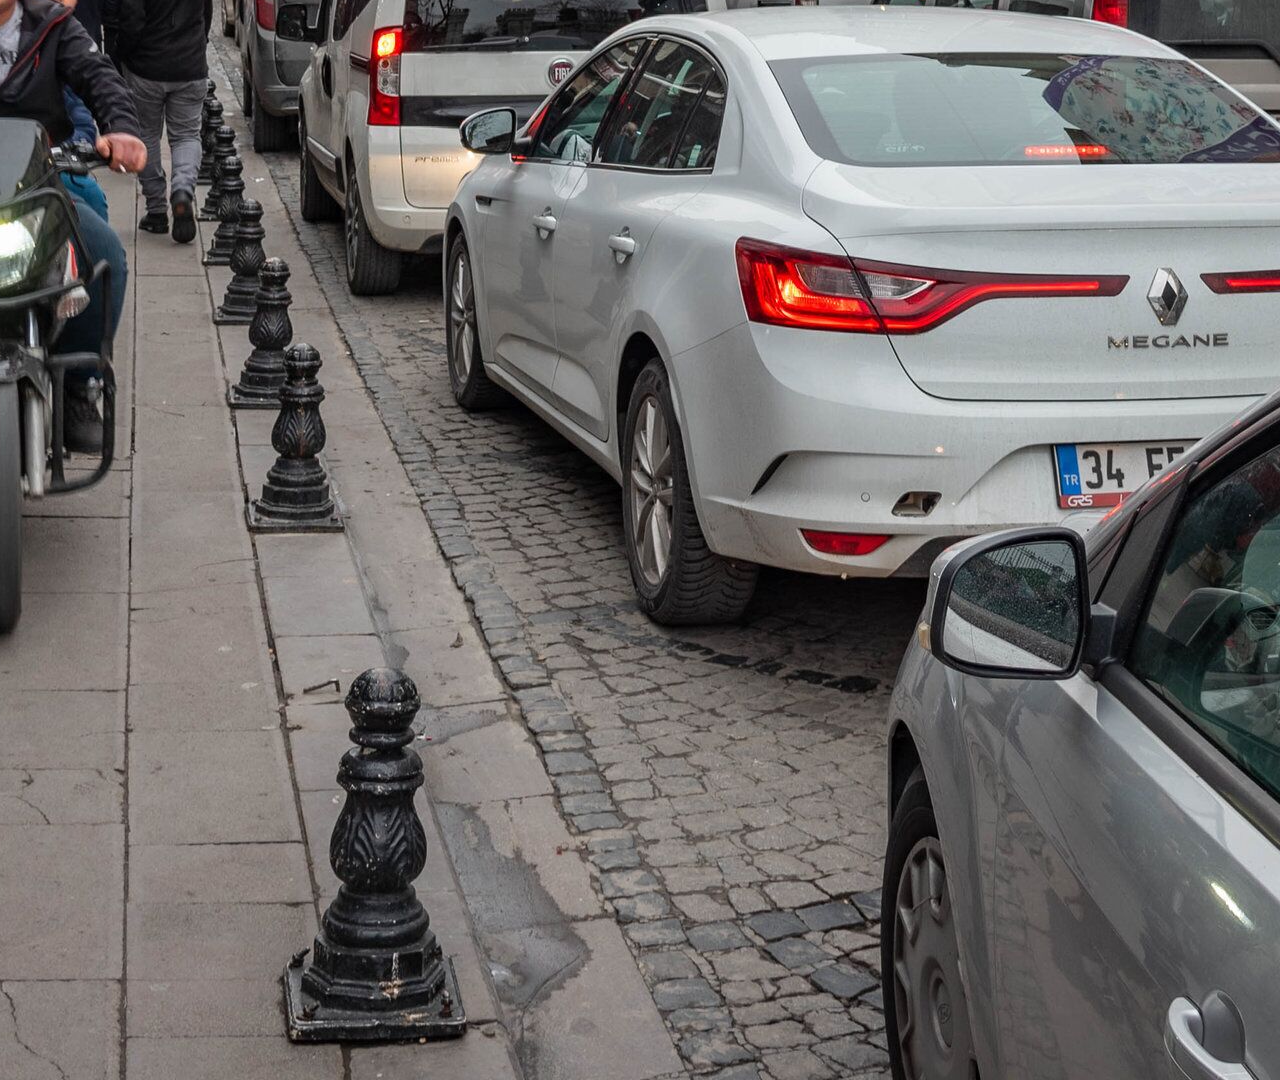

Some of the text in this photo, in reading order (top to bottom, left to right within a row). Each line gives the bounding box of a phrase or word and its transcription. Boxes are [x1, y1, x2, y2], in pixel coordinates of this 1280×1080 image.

[1107, 332, 1229, 349] MEGANE
[1082, 449, 1125, 489] 34
[1063, 474, 1079, 486] TR
[1068, 495, 1093, 507] GRS
